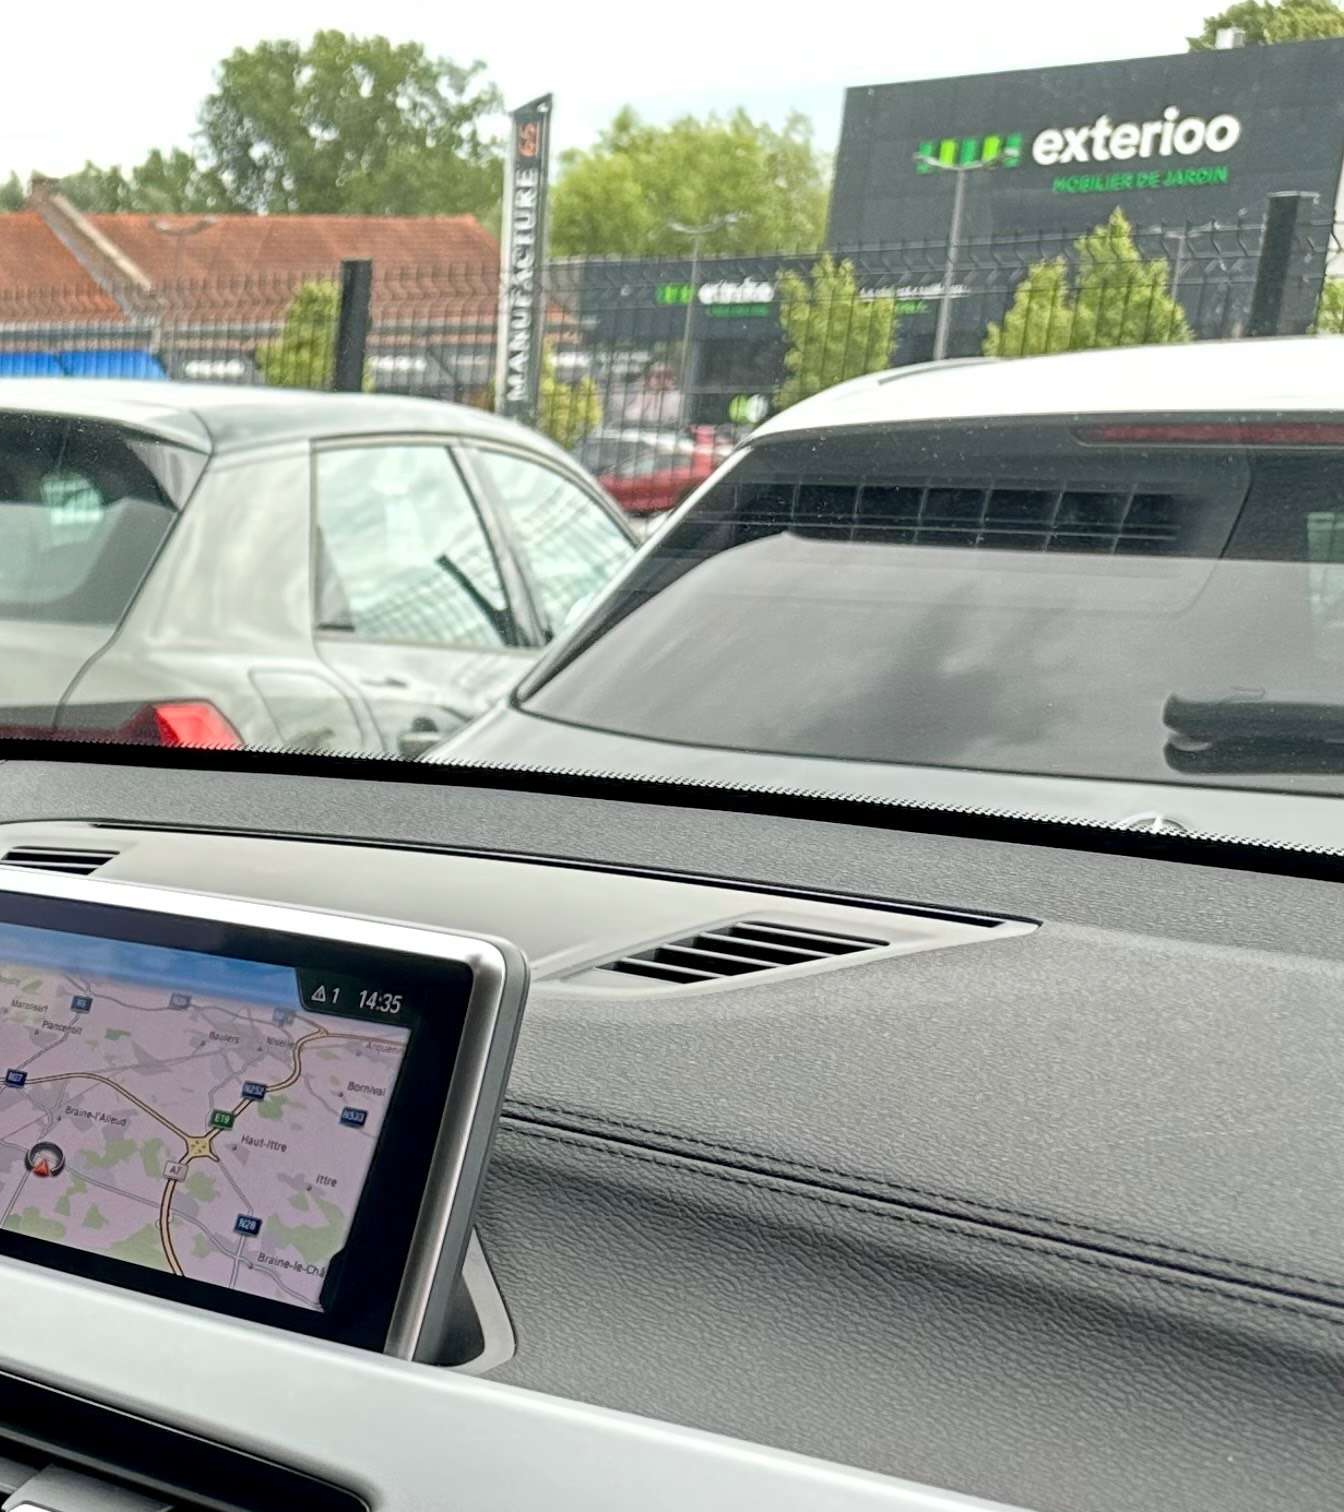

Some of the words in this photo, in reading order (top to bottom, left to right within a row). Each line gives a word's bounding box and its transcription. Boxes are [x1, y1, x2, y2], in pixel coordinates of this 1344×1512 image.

[1032, 106, 1241, 165] exterioo
[1052, 172, 1133, 193] MOBILIER
[1136, 171, 1162, 188] DE
[1163, 166, 1229, 186] JARDIN
[507, 167, 538, 401] MANUFACTURE
[332, 987, 340, 1004] 1
[359, 990, 403, 1014] 14:35
[241, 1134, 288, 1153] Haut-Ittre
[316, 1173, 338, 1187] Ittre
[238, 1217, 256, 1231] N28
